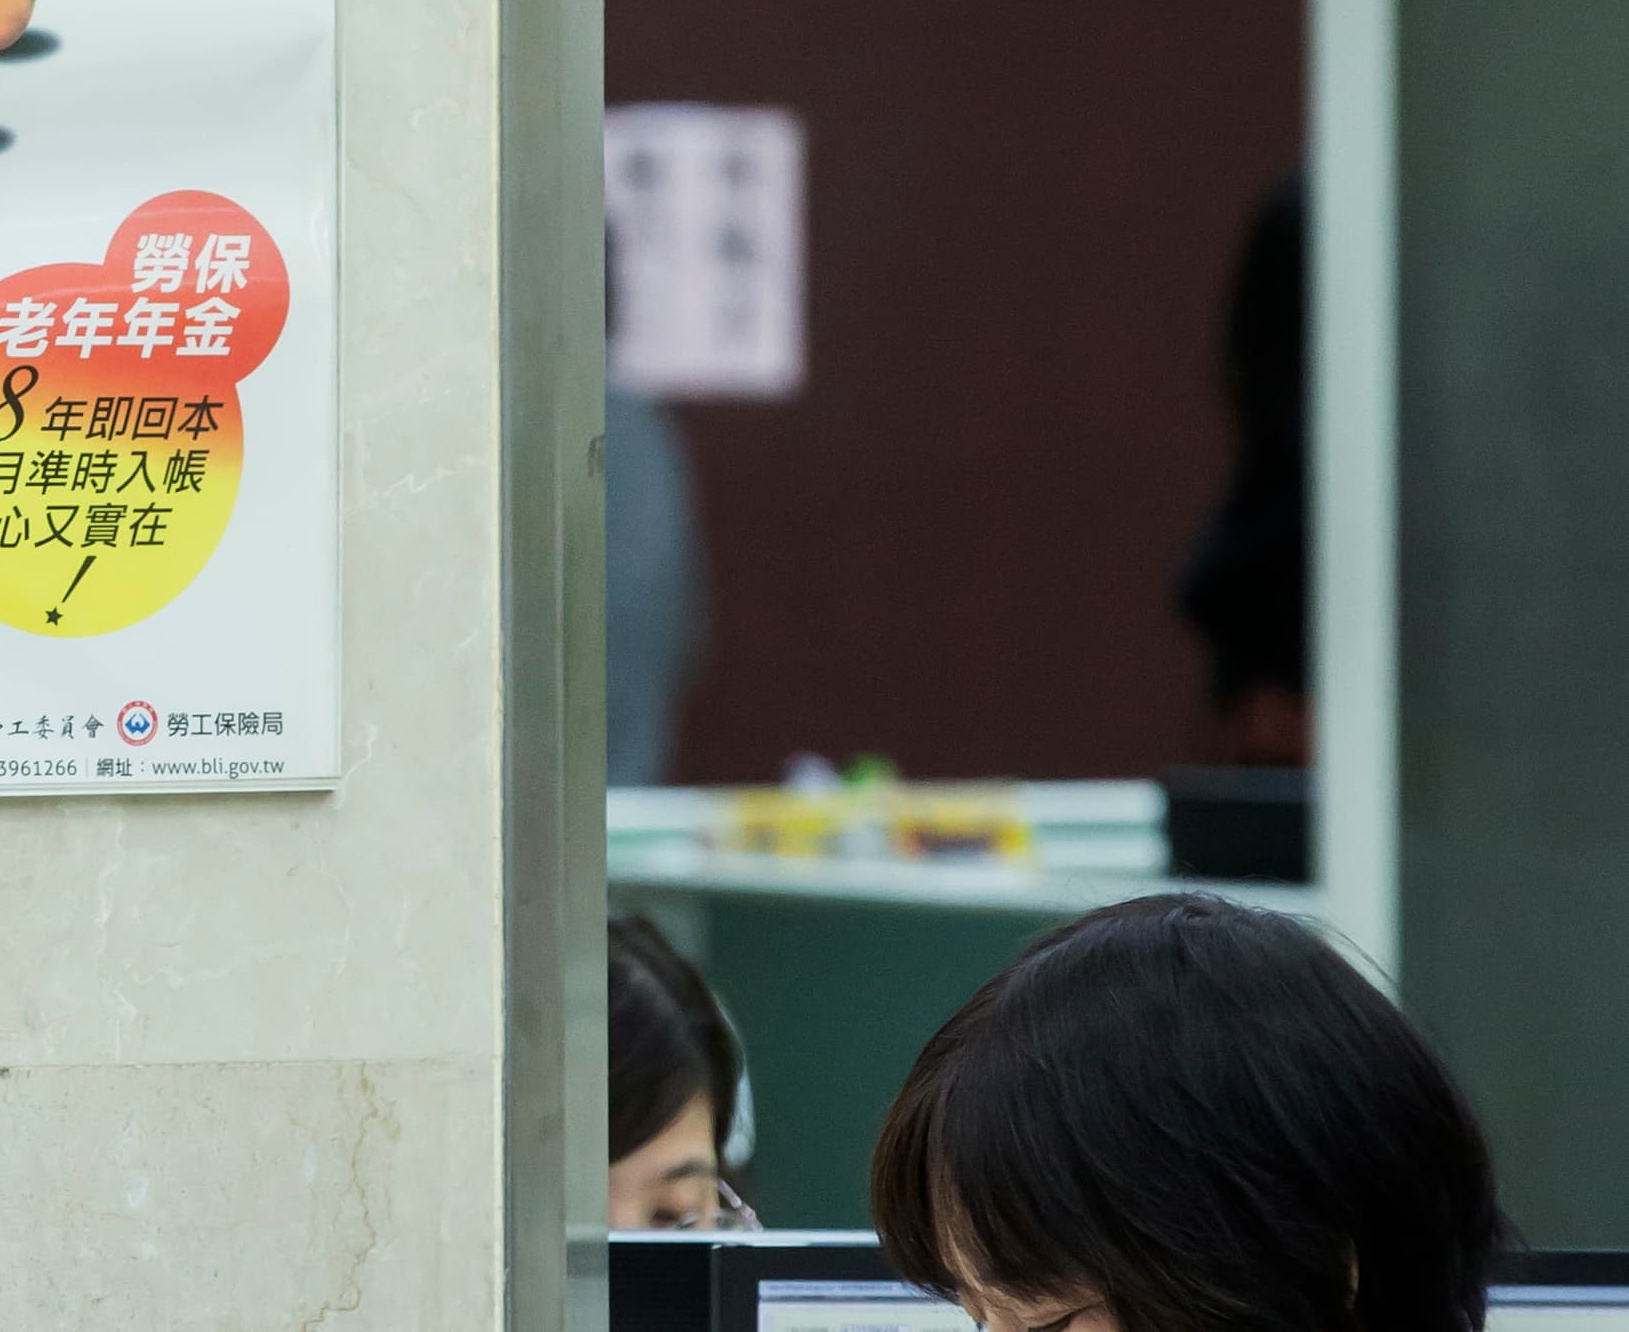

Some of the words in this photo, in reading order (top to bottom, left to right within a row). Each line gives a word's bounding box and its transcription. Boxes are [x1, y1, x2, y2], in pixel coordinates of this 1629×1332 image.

[131, 233, 252, 295] 勞保
[167, 711, 283, 737] 勞工保險局
